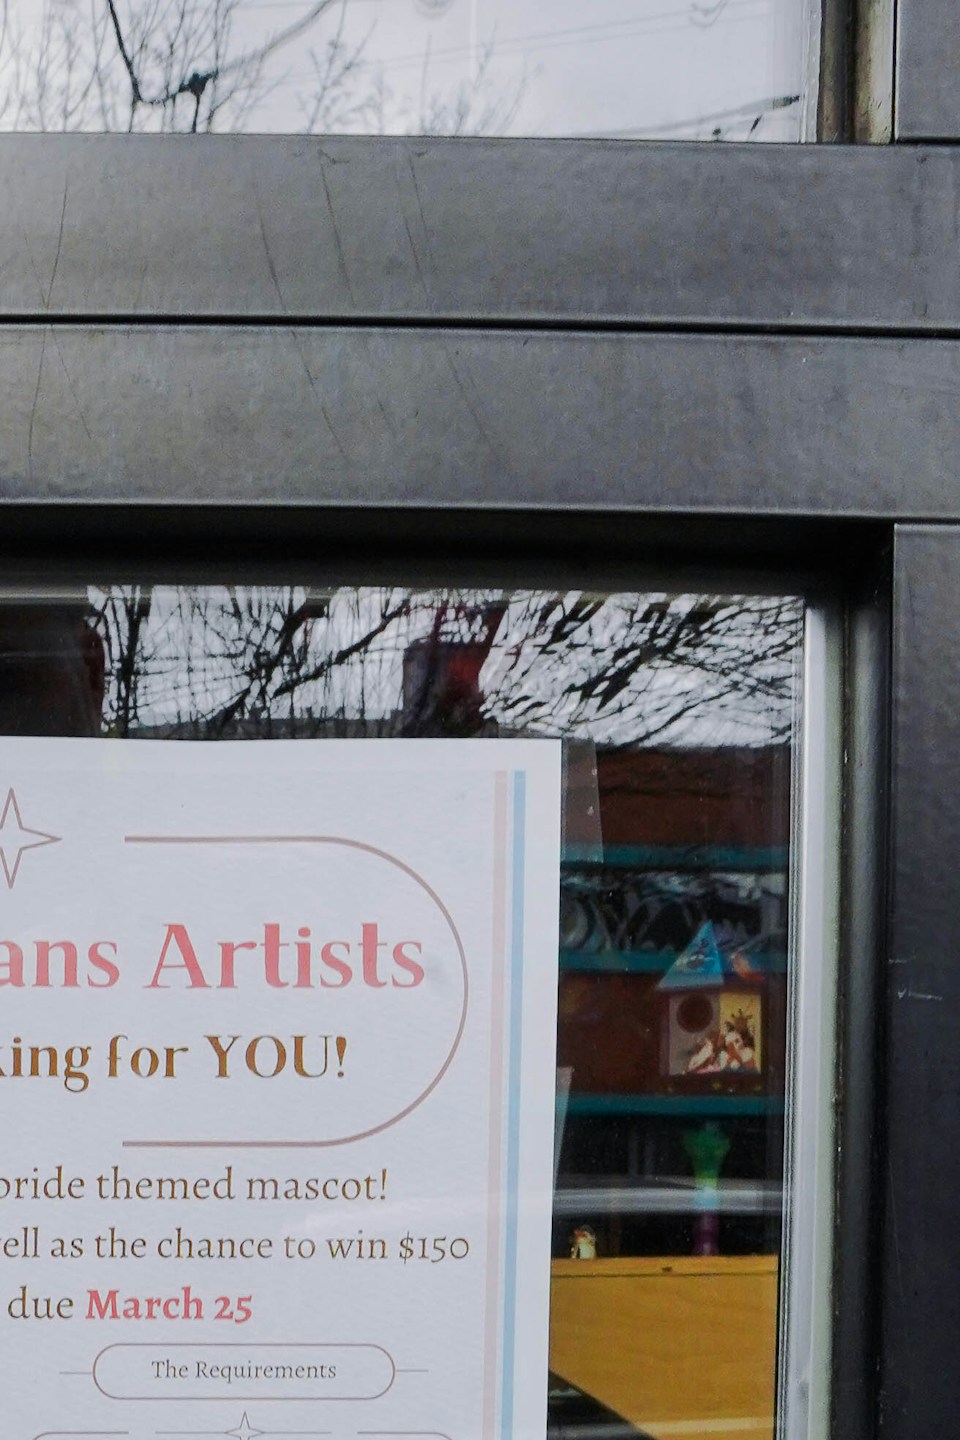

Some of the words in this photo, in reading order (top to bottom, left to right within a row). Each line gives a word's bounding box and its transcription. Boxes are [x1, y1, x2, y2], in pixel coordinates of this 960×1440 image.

[144, 922, 425, 989] Artists
[106, 1034, 190, 1079] for
[202, 1034, 348, 1079] YOU!
[95, 1164, 236, 1201] themed
[246, 1167, 388, 1201] mascot!
[50, 1237, 84, 1259] as
[94, 1225, 147, 1259] the
[157, 1226, 273, 1260] chance
[283, 1235, 317, 1260] to
[325, 1229, 388, 1260] win
[398, 1230, 470, 1265] $150
[7, 1284, 75, 1321] due
[84, 1285, 205, 1321] March
[213, 1294, 253, 1325] 25
[151, 1358, 189, 1379] The
[195, 1359, 337, 1385] Requirements
